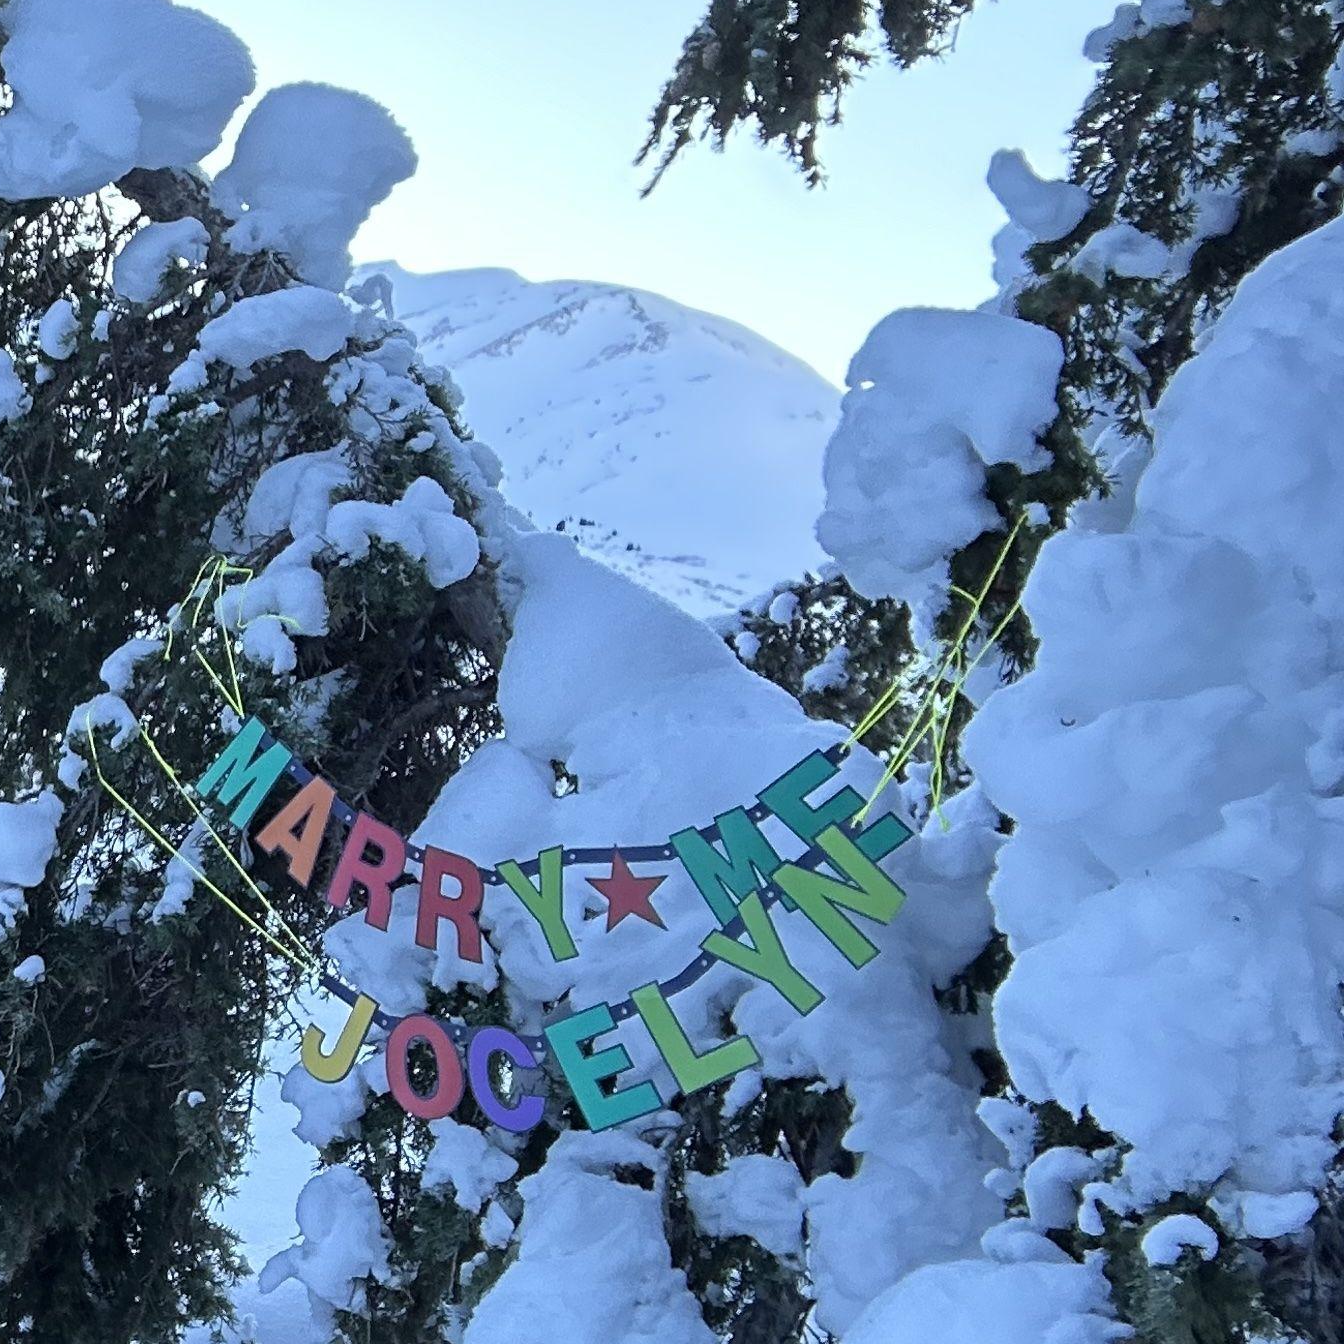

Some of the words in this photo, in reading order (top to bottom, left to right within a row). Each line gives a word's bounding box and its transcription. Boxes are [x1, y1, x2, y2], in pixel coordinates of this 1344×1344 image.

[196, 716, 579, 964] MARRY
[669, 748, 914, 929] ME
[301, 823, 907, 1133] JOCELYN
